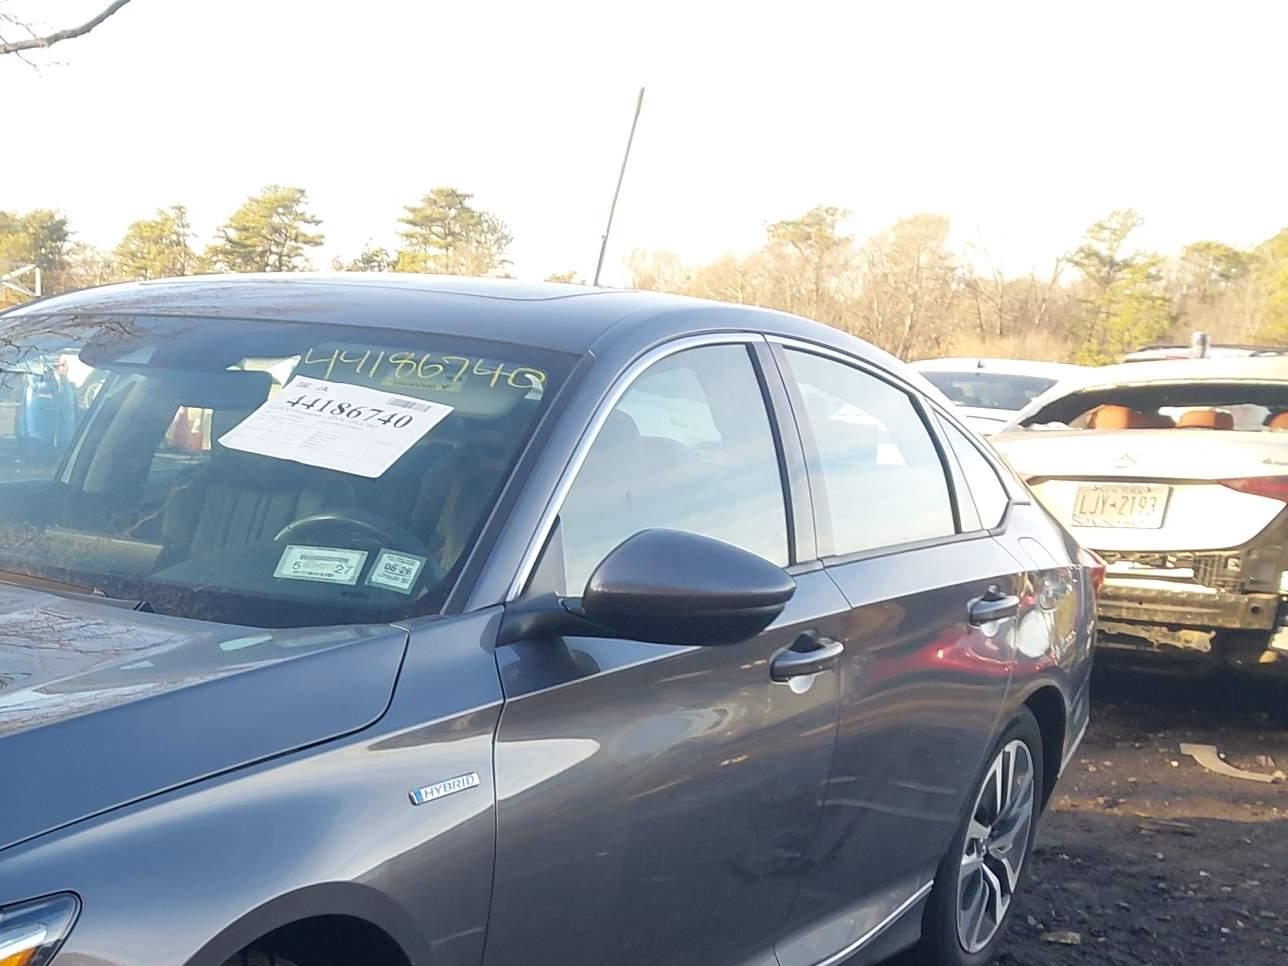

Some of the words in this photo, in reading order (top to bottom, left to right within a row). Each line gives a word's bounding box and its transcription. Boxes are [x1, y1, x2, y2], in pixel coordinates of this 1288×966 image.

[304, 347, 546, 388] 44186740
[286, 395, 414, 429] 44186740
[334, 564, 354, 575] 27
[424, 774, 476, 799] HYBRID
